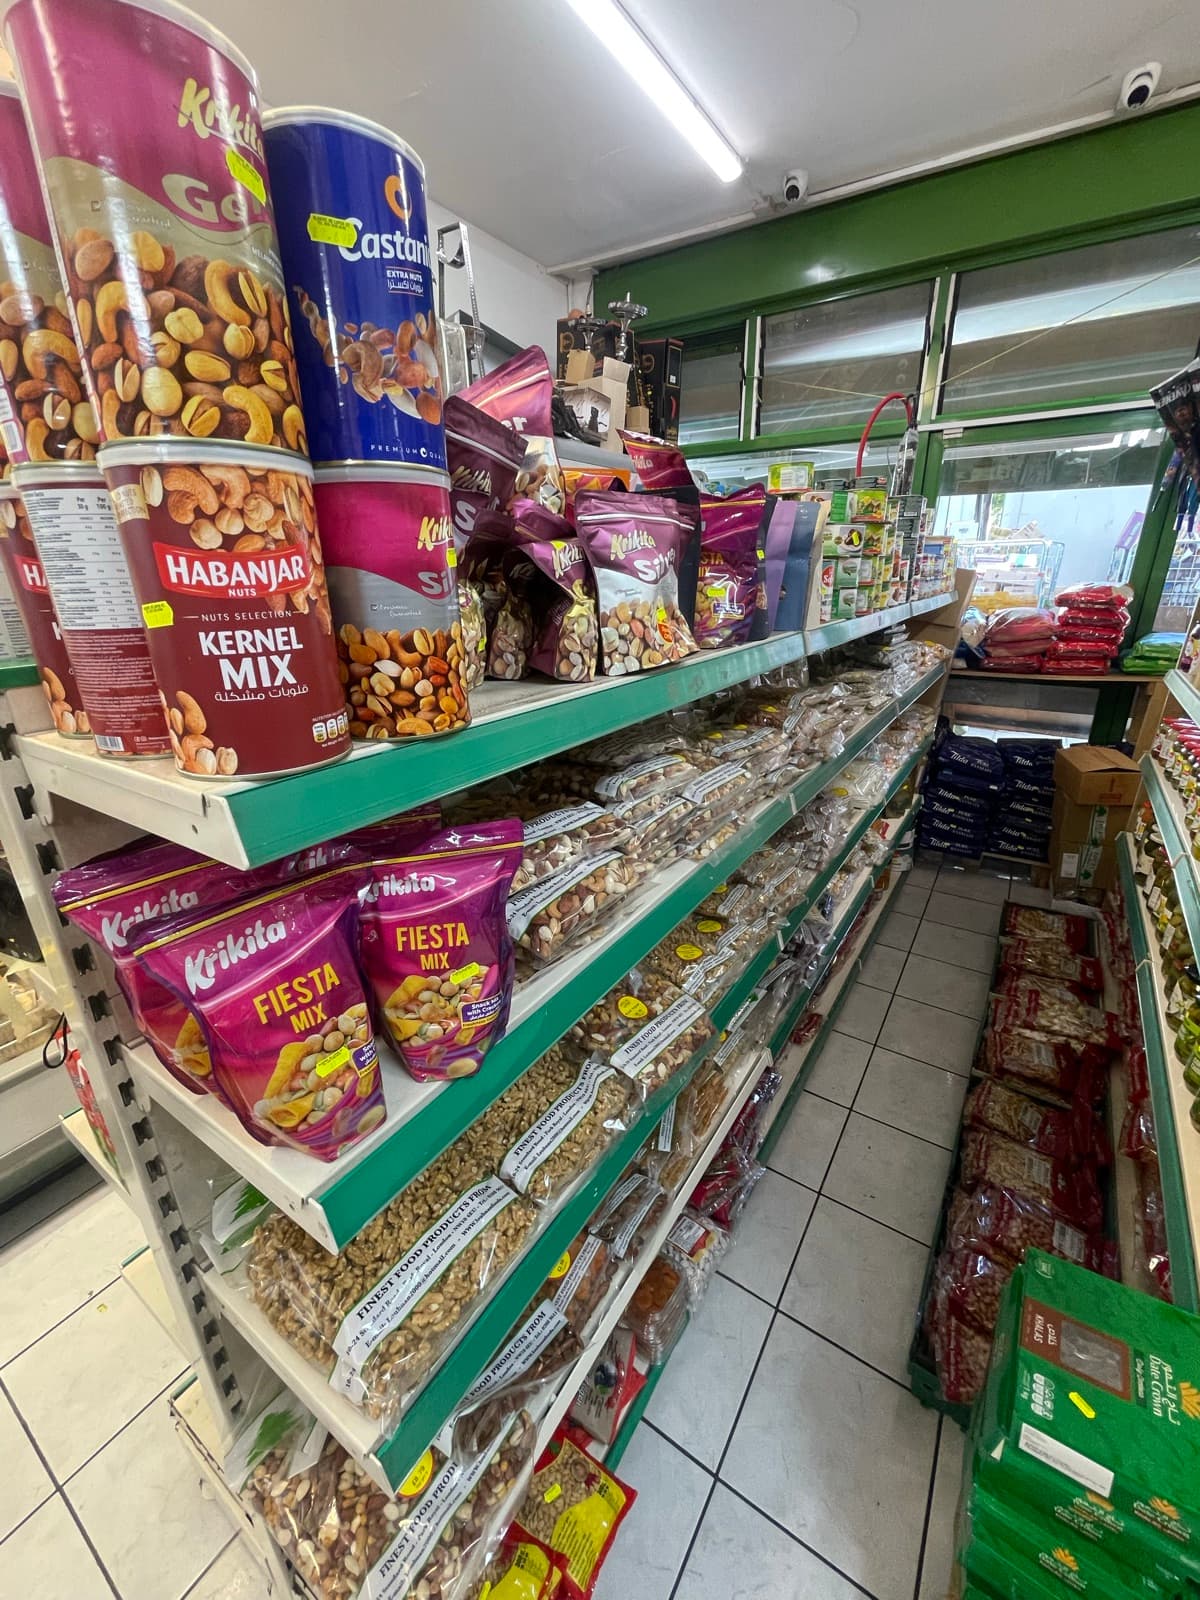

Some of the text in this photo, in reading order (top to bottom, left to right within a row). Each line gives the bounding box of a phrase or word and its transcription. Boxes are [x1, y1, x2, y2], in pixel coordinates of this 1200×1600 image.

[386, 270, 409, 280] EXTRA
[370, 444, 418, 454] PREMIUM
[610, 529, 656, 561] Krikita
[165, 554, 306, 592] HABANJAR
[228, 588, 257, 598] NUTS
[201, 610, 292, 623] NUTS SELECTION
[198, 626, 304, 657] KERNEL
[219, 653, 298, 691] MIX
[214, 685, 309, 703] قلوبات مشكلة
[950, 750, 969, 765] Tilda
[1014, 755, 1034, 767] Tilda
[101, 888, 199, 951] Krikita
[396, 922, 471, 952] FIESTA
[184, 919, 288, 996] Krikita
[420, 952, 450, 971] MIX
[253, 961, 341, 1025] FIESTA
[290, 1001, 328, 1034] MIX
[466, 1008, 481, 1016] with
[514, 1130, 539, 1157] FINEST
[536, 1110, 556, 1131] FOOD
[554, 1081, 585, 1113] PRODUCTS
[356, 1184, 493, 1321] FINEST FOOD PRODUCTS FROM
[1033, 1313, 1045, 1345] KHALAS
[469, 1311, 547, 1397] FOOD PRODUCTS FROM
[1149, 1354, 1164, 1418] Date Crown
[379, 1532, 410, 1579] FINEST
[408, 1499, 434, 1534] FOOD
